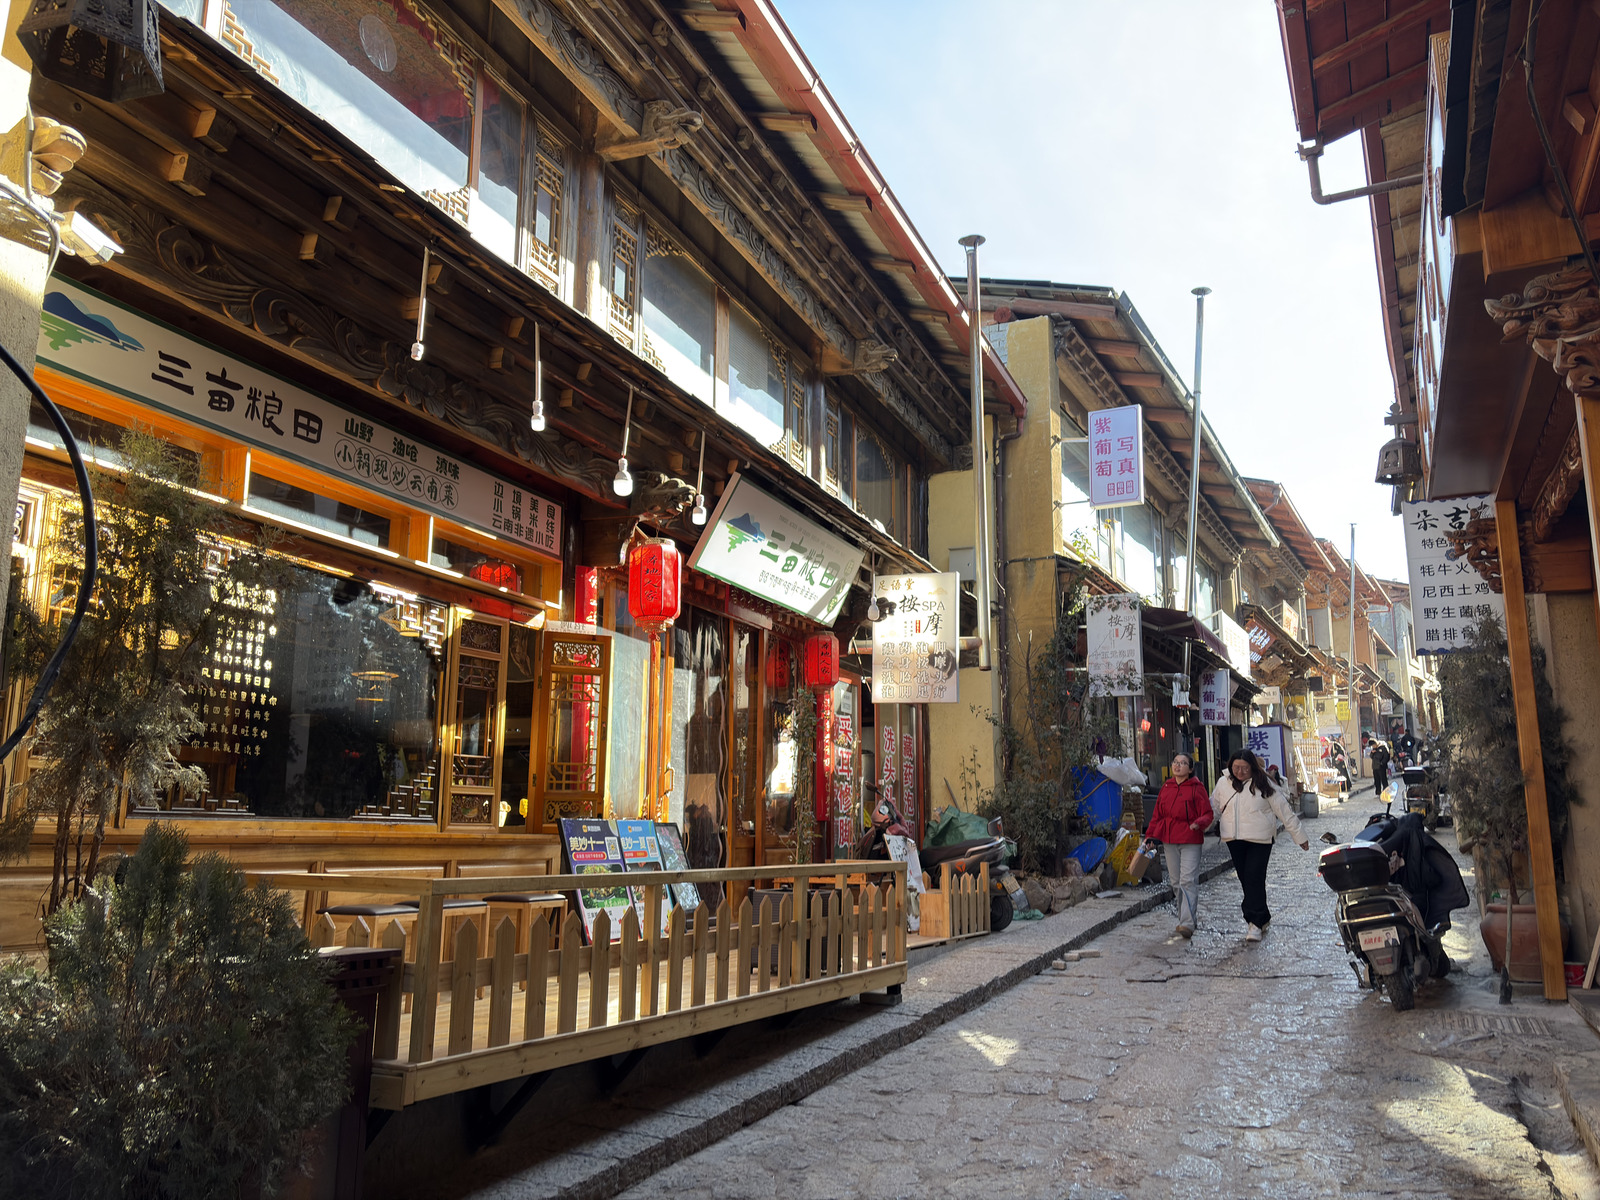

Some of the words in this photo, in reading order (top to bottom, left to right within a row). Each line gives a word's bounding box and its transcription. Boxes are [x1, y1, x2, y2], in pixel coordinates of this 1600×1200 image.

[344, 416, 375, 444] 山野
[435, 455, 461, 481] 滇味
[1094, 416, 1113, 477] 紫葡萄
[1117, 435, 1136, 476] 写真
[336, 443, 456, 508] 小锅现炒云南菜
[493, 480, 556, 521] 边境美食
[492, 497, 556, 535] 小锅米线
[491, 512, 555, 551] 云南非遗小吃
[1419, 561, 1481, 577] 牦牛火
[1422, 581, 1490, 599] 尼西土鸡
[921, 600, 946, 612] SPA
[1423, 603, 1492, 620] 野生菌锅
[1123, 615, 1137, 623] SPA
[1425, 625, 1483, 642] 腊排骨
[881, 656, 947, 670] 全身按摩
[201, 667, 271, 689] 风里雨里节日里
[881, 671, 947, 685] 洗脸洗头
[881, 684, 947, 699] 泡脚足疗
[1201, 673, 1216, 721] 紫葡萄
[190, 702, 271, 722] 没有四季只有两季
[1216, 697, 1227, 721] 写真
[190, 738, 262, 758] 你不来就是淡季
[838, 715, 853, 848] 采耳修脚
